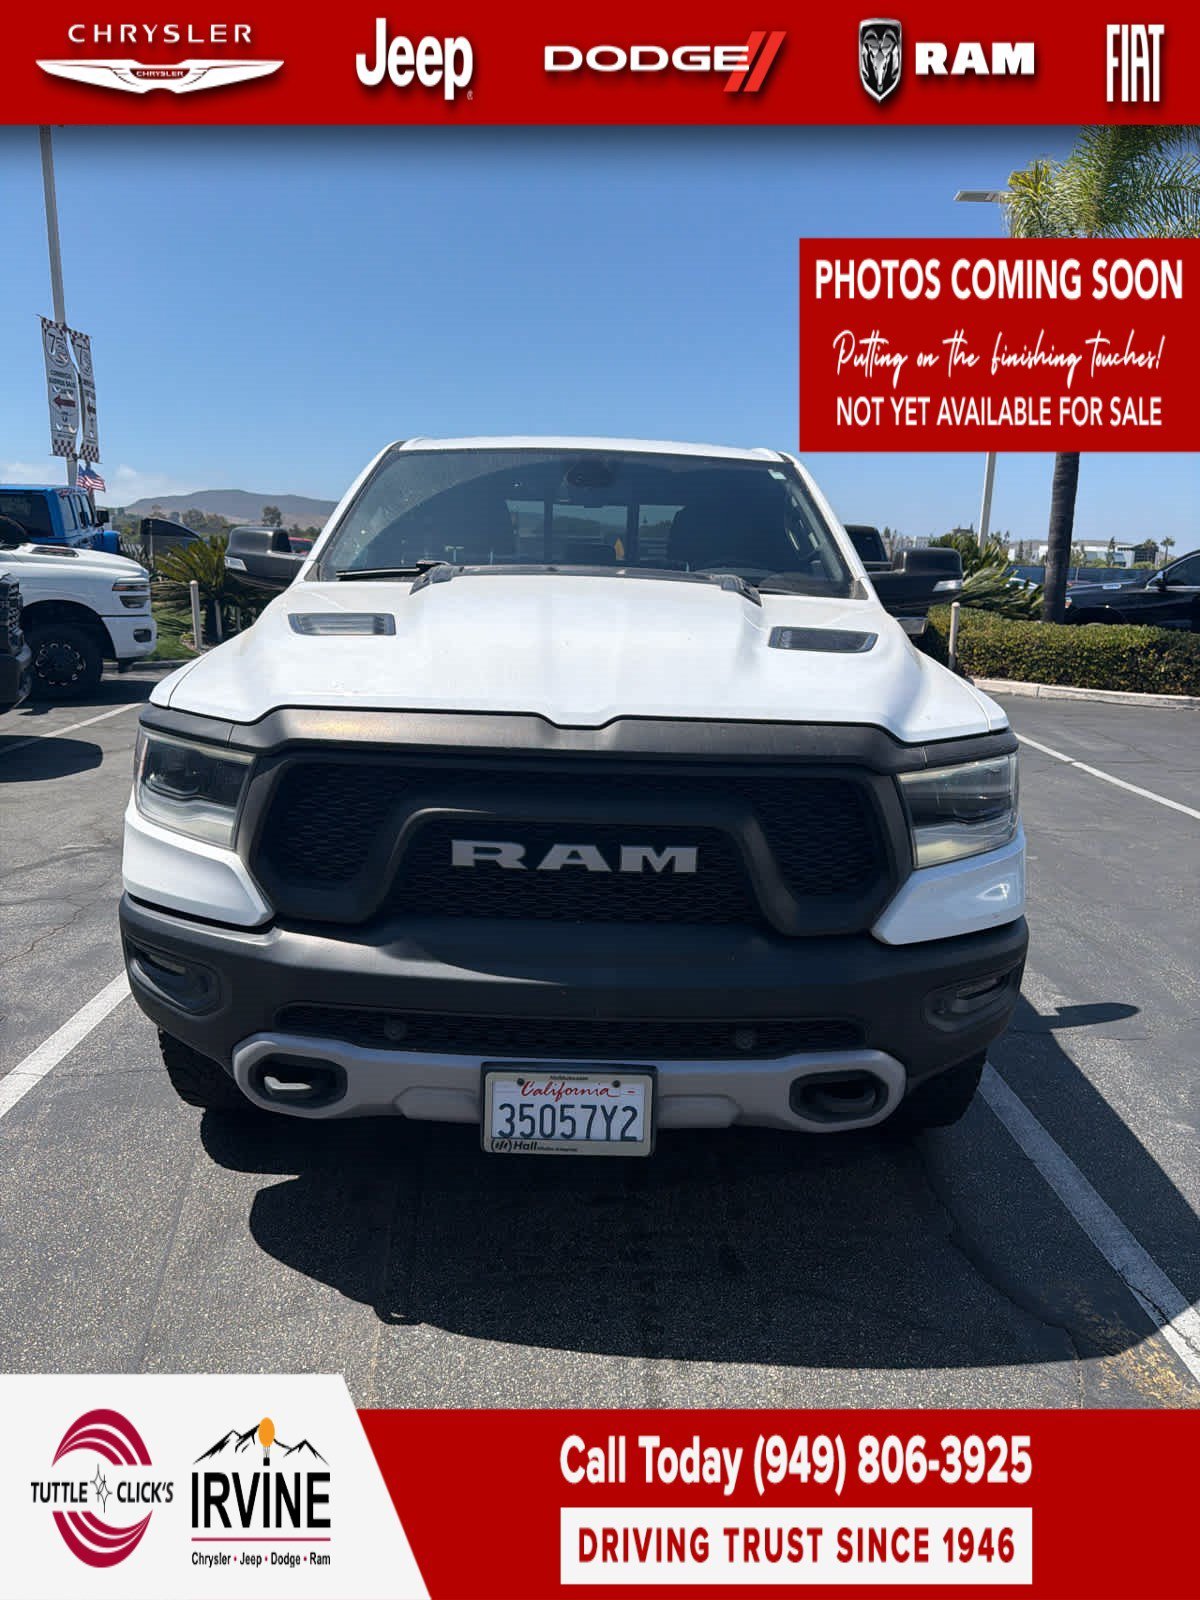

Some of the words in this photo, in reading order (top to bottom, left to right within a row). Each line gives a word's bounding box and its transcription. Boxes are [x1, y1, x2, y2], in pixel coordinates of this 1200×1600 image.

[451, 840, 698, 873] RAM
[521, 1080, 618, 1102] California
[497, 1103, 638, 1141] 35057Y2
[513, 1141, 538, 1152] Hall
